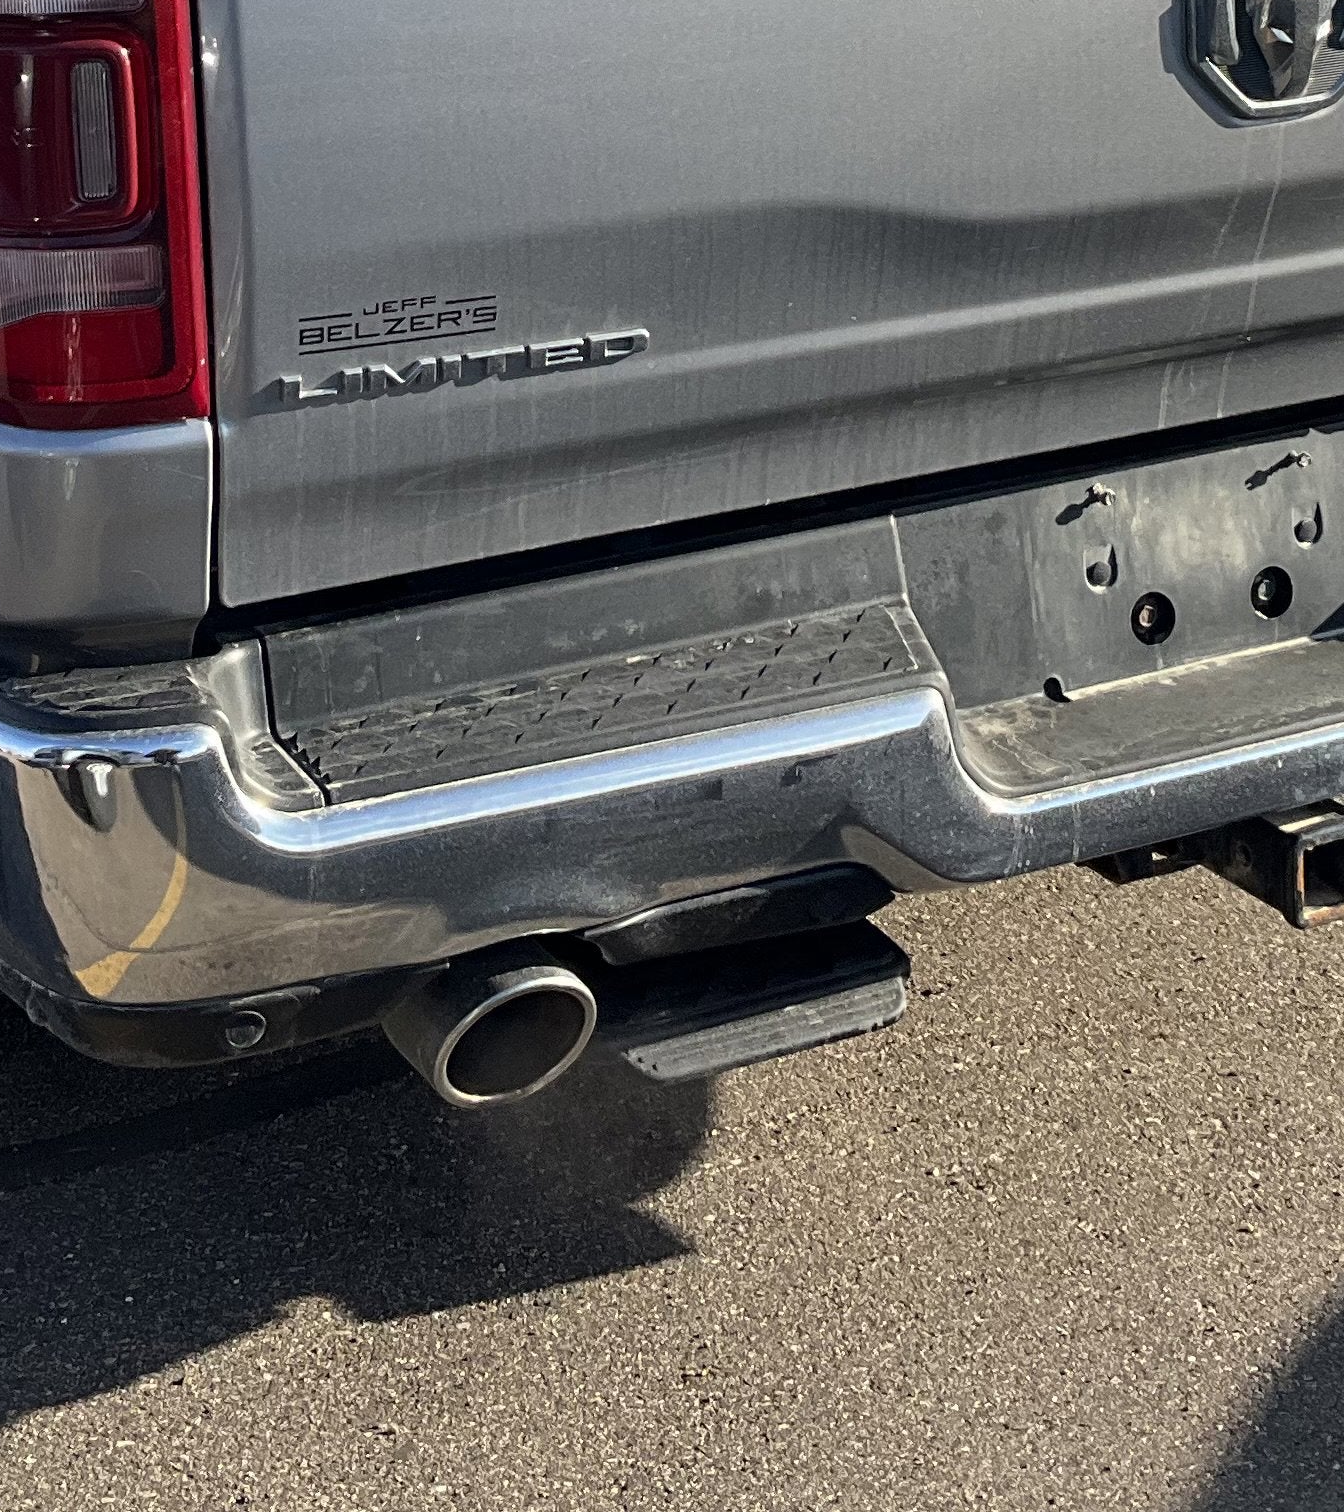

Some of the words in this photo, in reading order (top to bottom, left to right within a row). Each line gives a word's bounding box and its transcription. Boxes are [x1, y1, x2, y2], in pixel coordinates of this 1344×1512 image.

[298, 305, 498, 347] BELZER'S
[362, 295, 438, 317] JEFF
[279, 327, 651, 404] LIMITED
